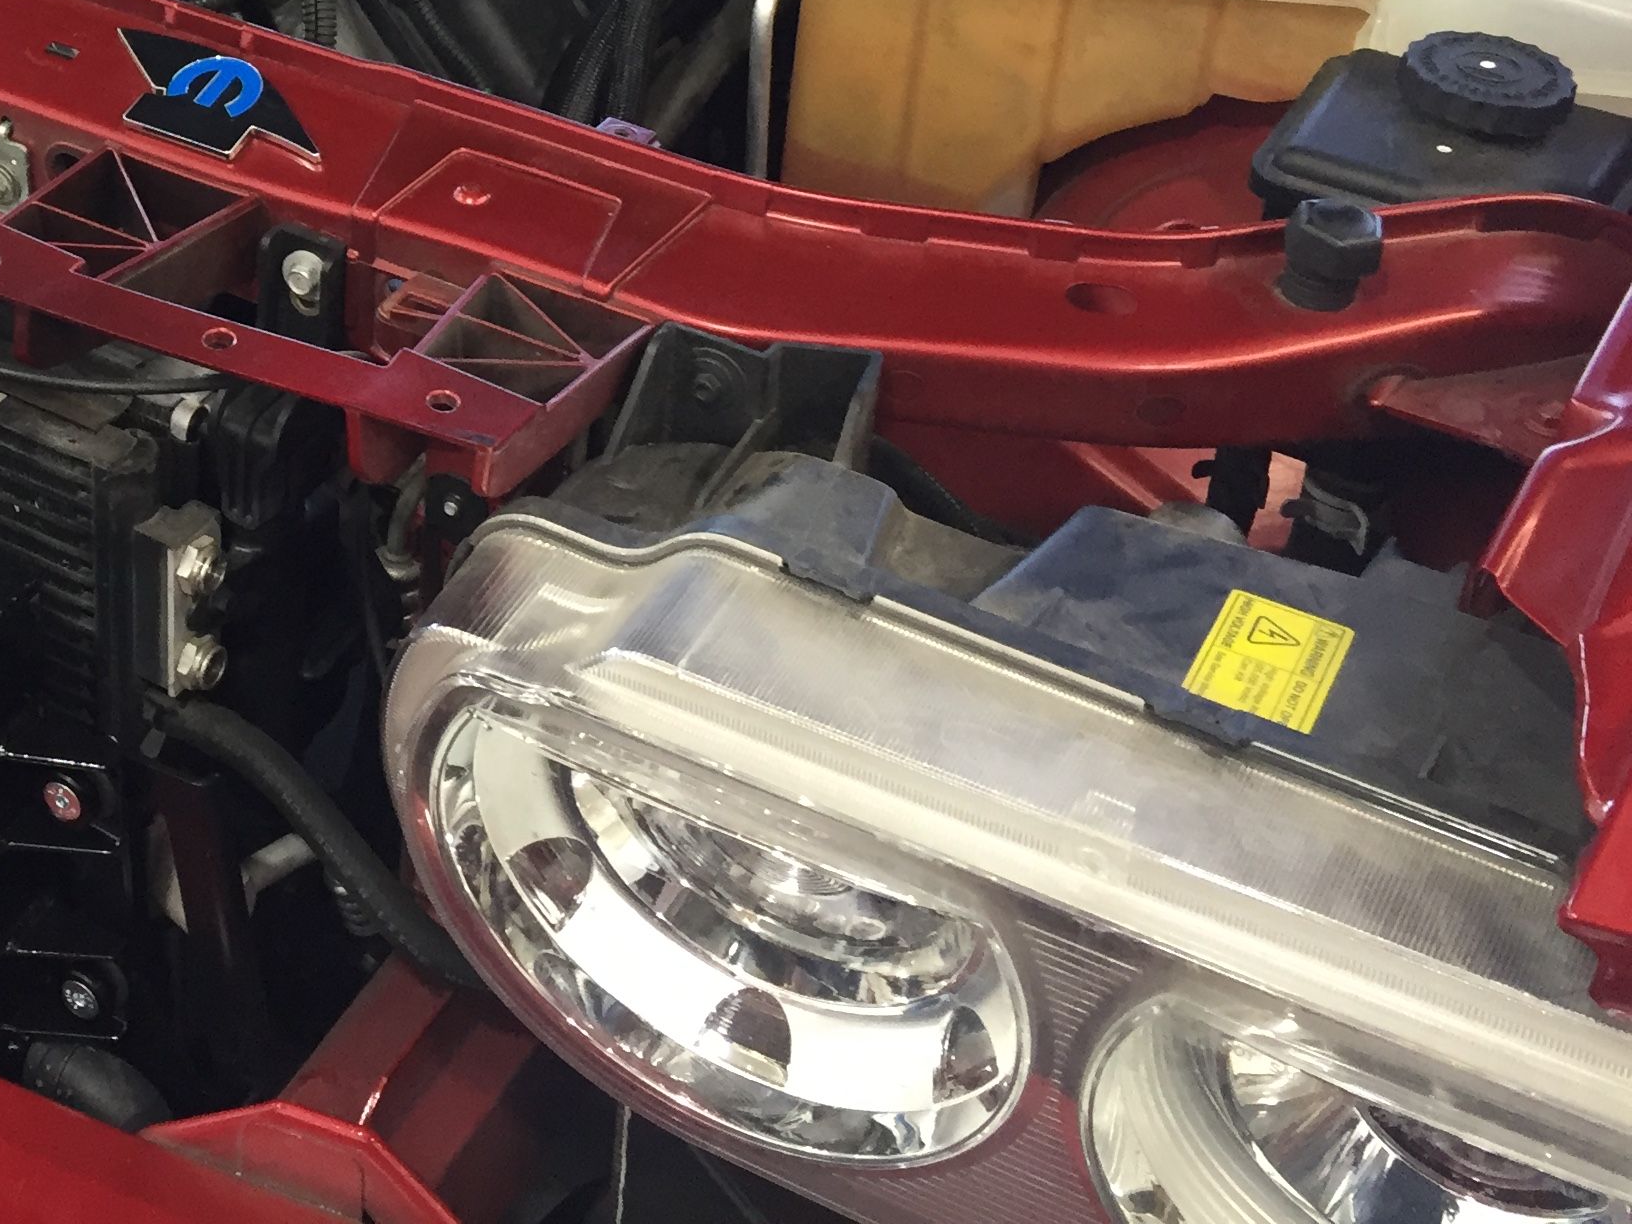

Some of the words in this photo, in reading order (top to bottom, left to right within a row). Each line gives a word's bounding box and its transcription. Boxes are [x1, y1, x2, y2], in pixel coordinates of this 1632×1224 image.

[1220, 615, 1245, 648] VOLTAGE
[1299, 636, 1329, 678] WARNING
[1291, 679, 1308, 694] DO
[1283, 692, 1301, 710] NOT
